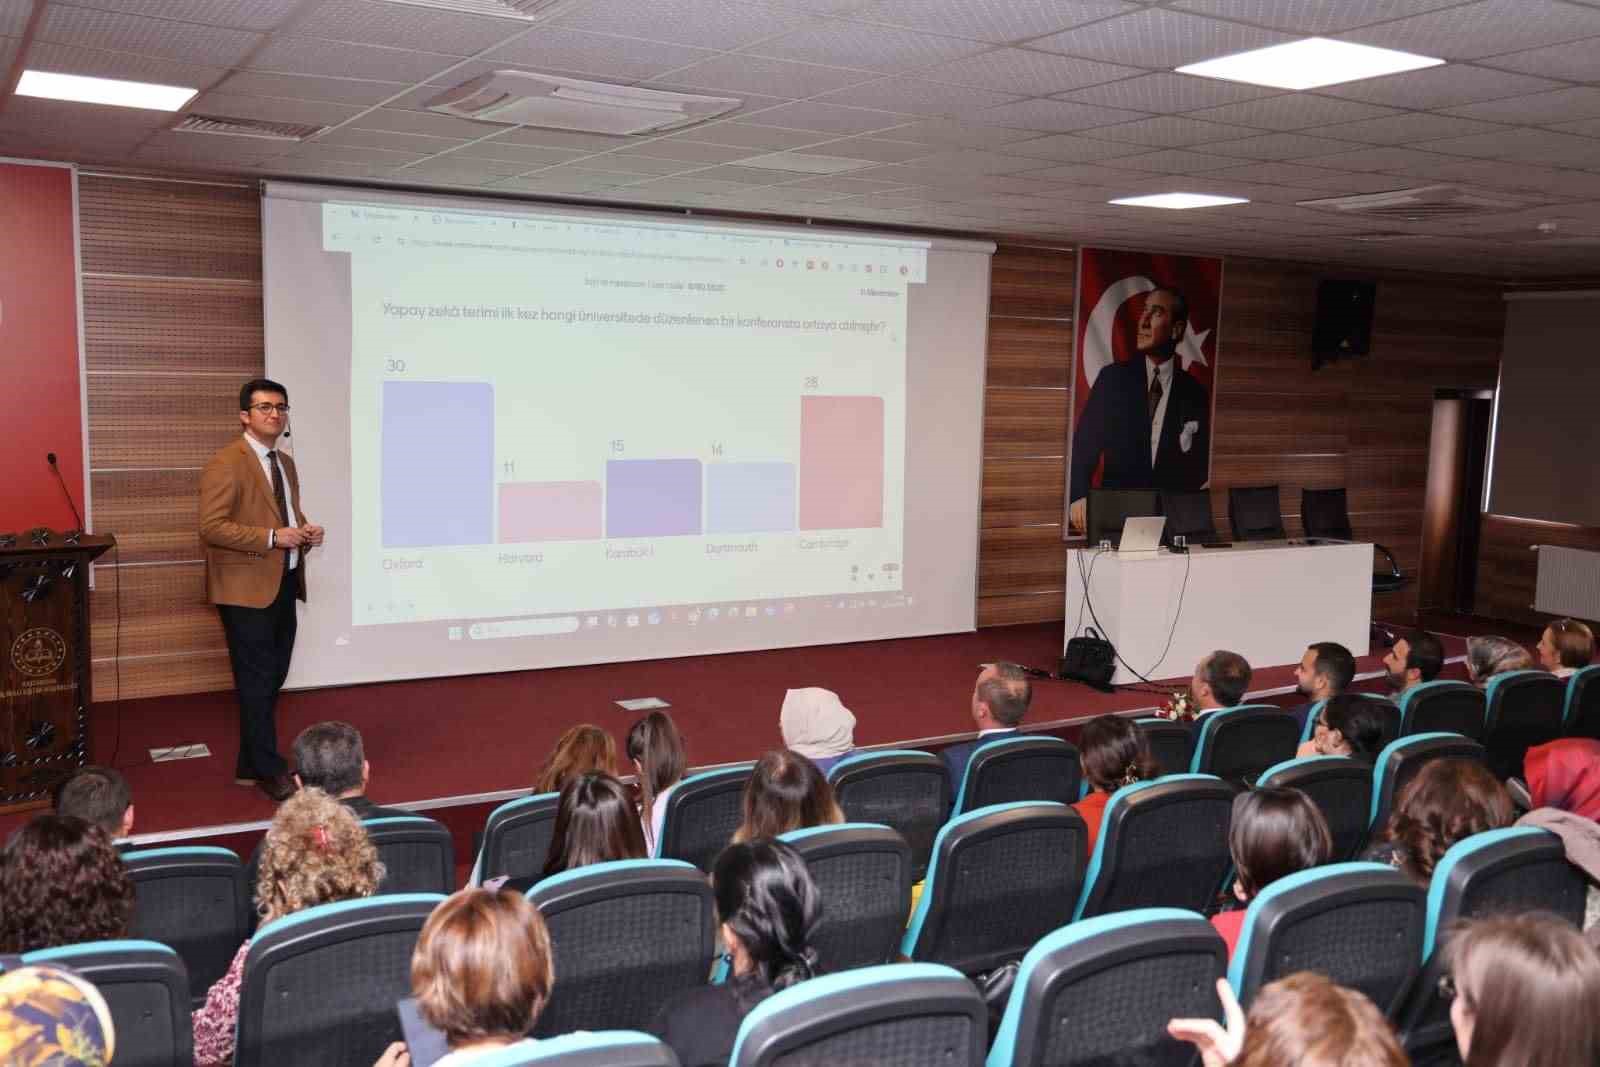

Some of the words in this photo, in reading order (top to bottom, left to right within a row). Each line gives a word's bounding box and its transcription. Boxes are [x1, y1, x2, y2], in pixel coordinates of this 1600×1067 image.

[384, 302, 427, 320] Yapay
[517, 307, 539, 321] kez
[540, 307, 576, 324] hangi
[387, 359, 406, 373] 30
[609, 439, 626, 453] 15
[711, 443, 723, 456] 14
[503, 460, 515, 474] 11
[705, 542, 760, 556] Dartmouth
